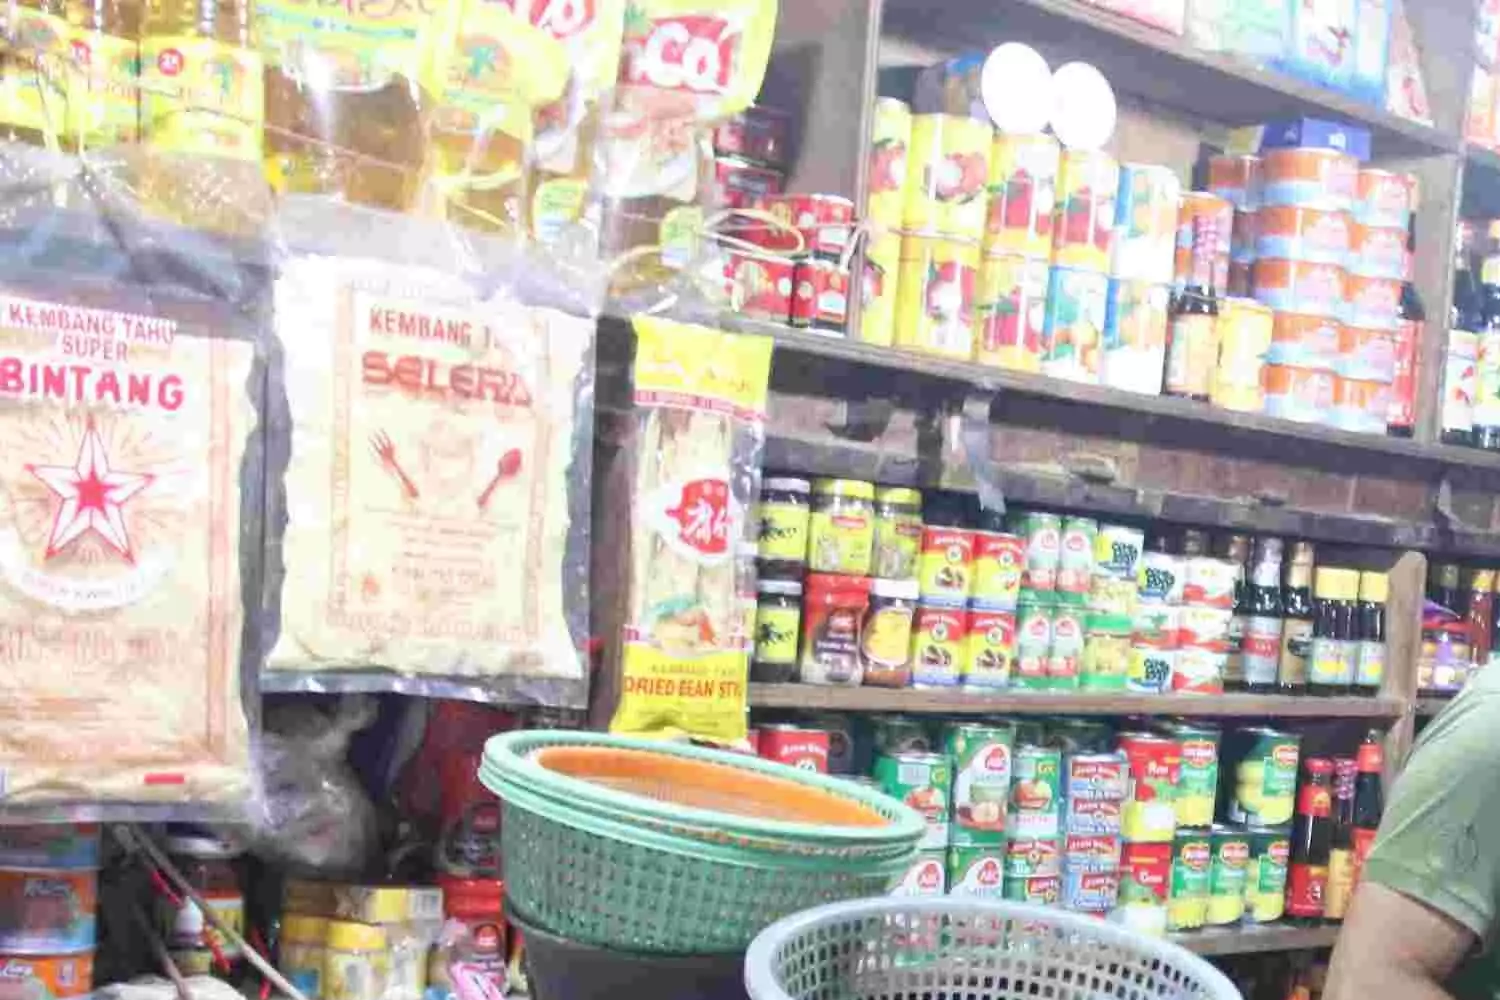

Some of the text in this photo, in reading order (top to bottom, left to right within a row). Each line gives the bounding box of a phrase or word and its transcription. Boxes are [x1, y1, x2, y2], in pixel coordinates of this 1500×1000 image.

[8, 302, 177, 345] KEMBANG TAHU
[368, 303, 472, 349] KEMBANG
[61, 333, 129, 362] SUPER
[0, 355, 185, 411] BINTANG
[623, 675, 674, 697] DRIED
[679, 677, 715, 698] BEAN
